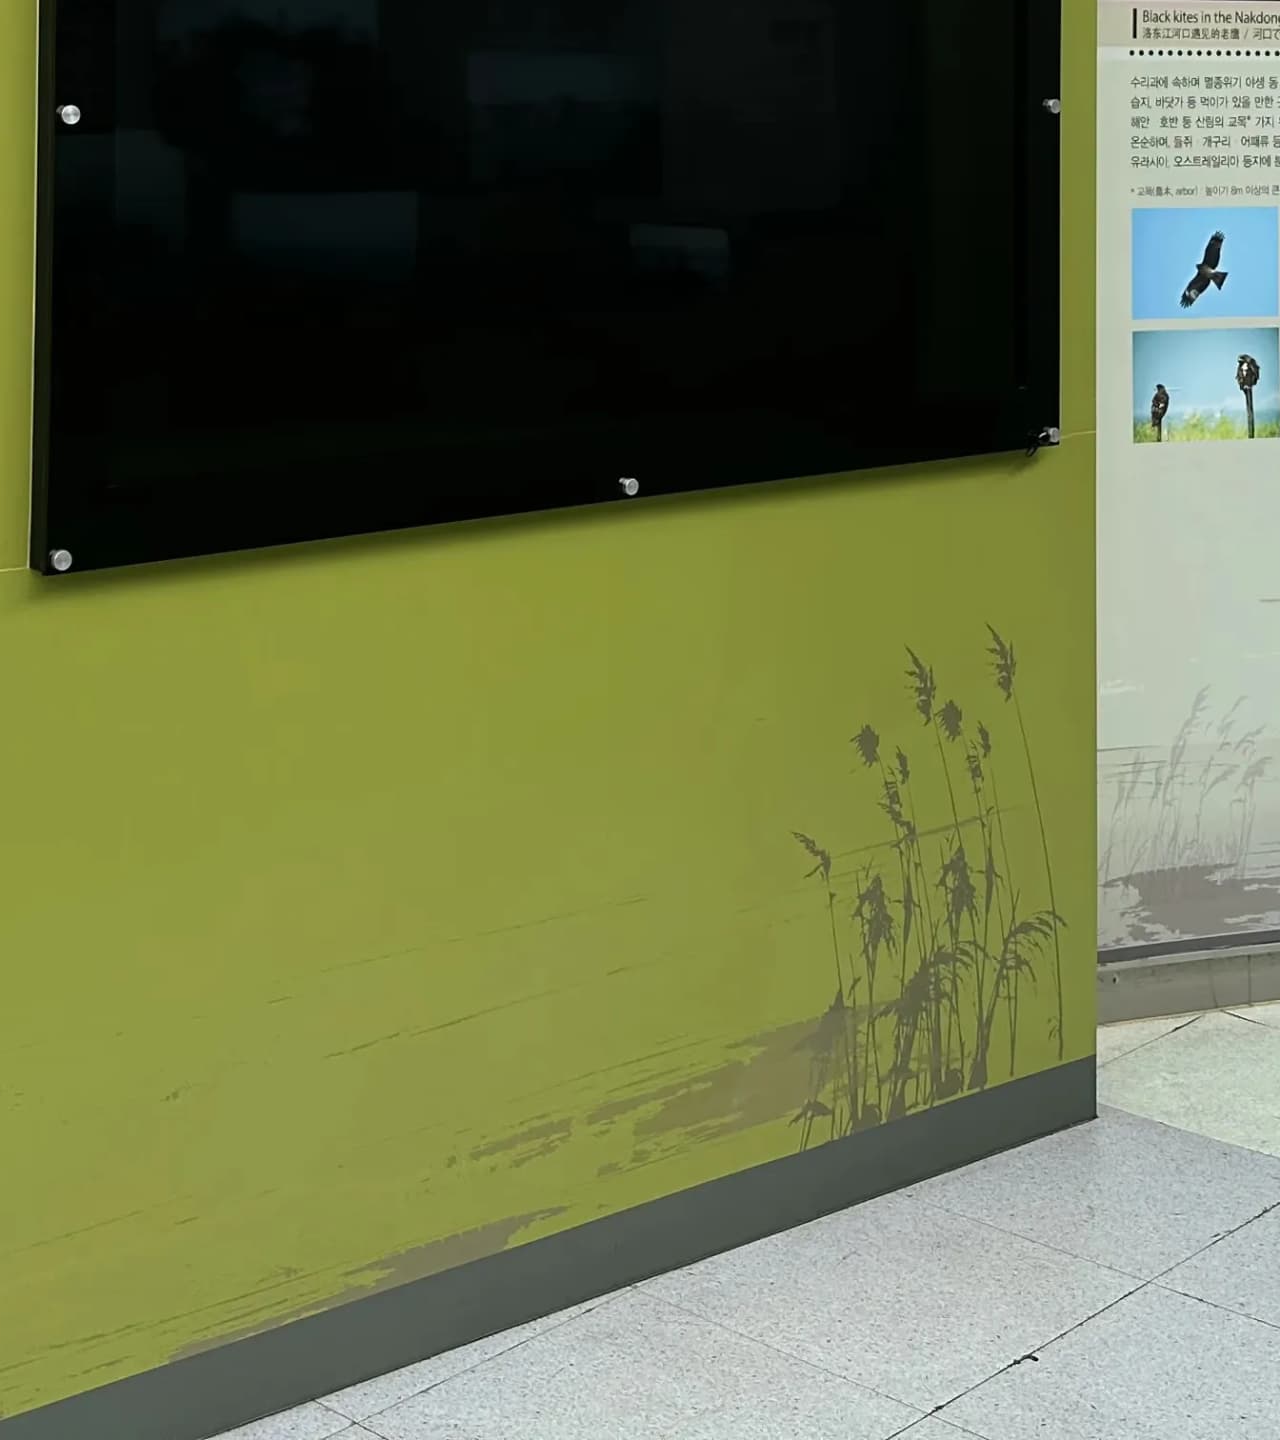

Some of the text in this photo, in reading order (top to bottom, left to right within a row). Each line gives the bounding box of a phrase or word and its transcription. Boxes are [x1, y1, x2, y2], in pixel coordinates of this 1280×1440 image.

[1143, 10, 1170, 23] Black
[1174, 10, 1198, 23] kites
[1201, 12, 1211, 23] in
[1214, 11, 1232, 23] the
[1131, 76, 1168, 88] 수리과에
[1172, 76, 1199, 88] 속하며
[1204, 77, 1241, 89] 멸종위기
[1246, 76, 1264, 89] 야생
[1156, 96, 1183, 108] 바닷가
[1200, 96, 1228, 108] 먹이가
[1232, 96, 1250, 108] 있을
[1255, 96, 1274, 108] 만한
[1131, 116, 1150, 128] 해안
[1160, 116, 1178, 128] 호반
[1196, 116, 1224, 128] 산림의
[1256, 116, 1274, 128] 가지
[1174, 136, 1192, 148] 들쥐
[1203, 136, 1230, 148] 개구리
[1241, 136, 1269, 148] 어패류
[1174, 155, 1239, 168] 오스트레일리아
[1243, 155, 1271, 168] 등지에
